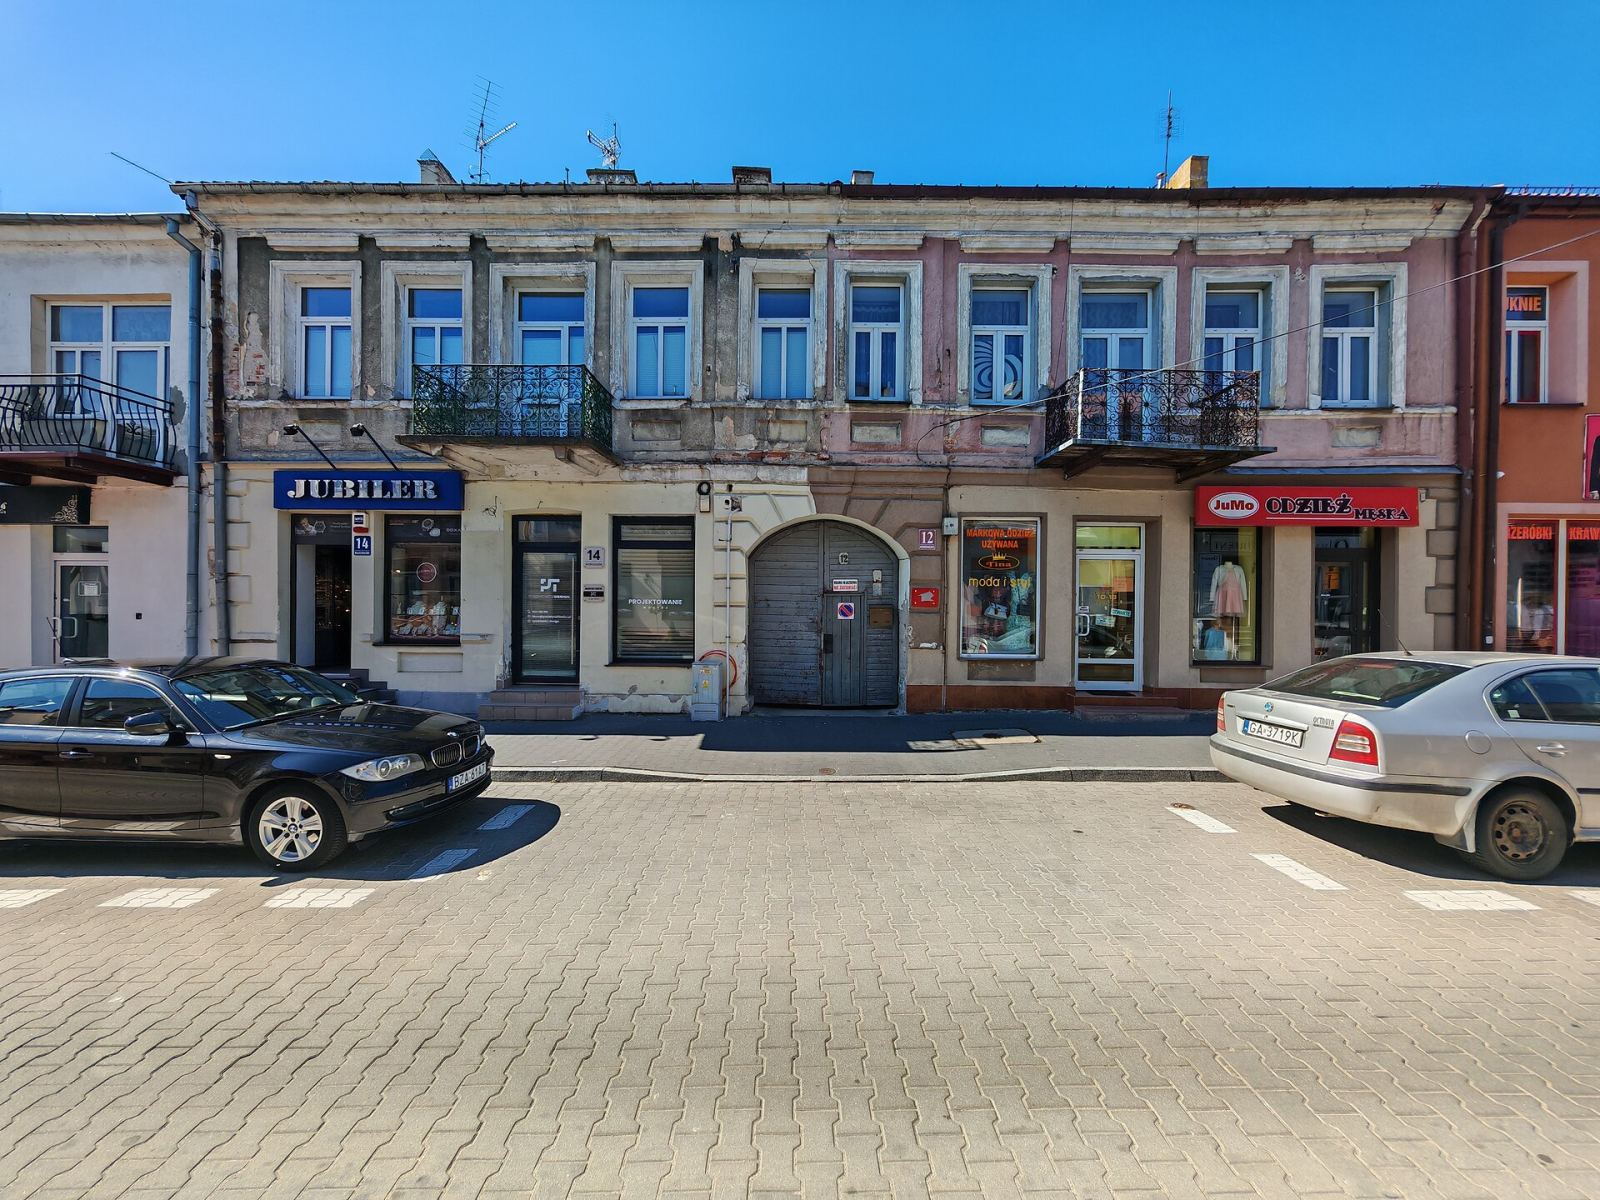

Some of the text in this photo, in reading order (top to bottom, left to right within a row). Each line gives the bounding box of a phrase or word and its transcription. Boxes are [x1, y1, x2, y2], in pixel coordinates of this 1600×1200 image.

[287, 479, 438, 499] JUBILER
[1213, 500, 1254, 510] JuMo
[1265, 493, 1352, 514] ODZIEŻ
[1354, 507, 1410, 521] MĘSKA
[355, 537, 369, 549] 14
[922, 531, 934, 544] 12
[587, 549, 600, 561] 14
[840, 553, 849, 564] 12
[968, 576, 1000, 588] moda
[1249, 722, 1299, 744] GA 3719K
[454, 771, 469, 788] BZA
